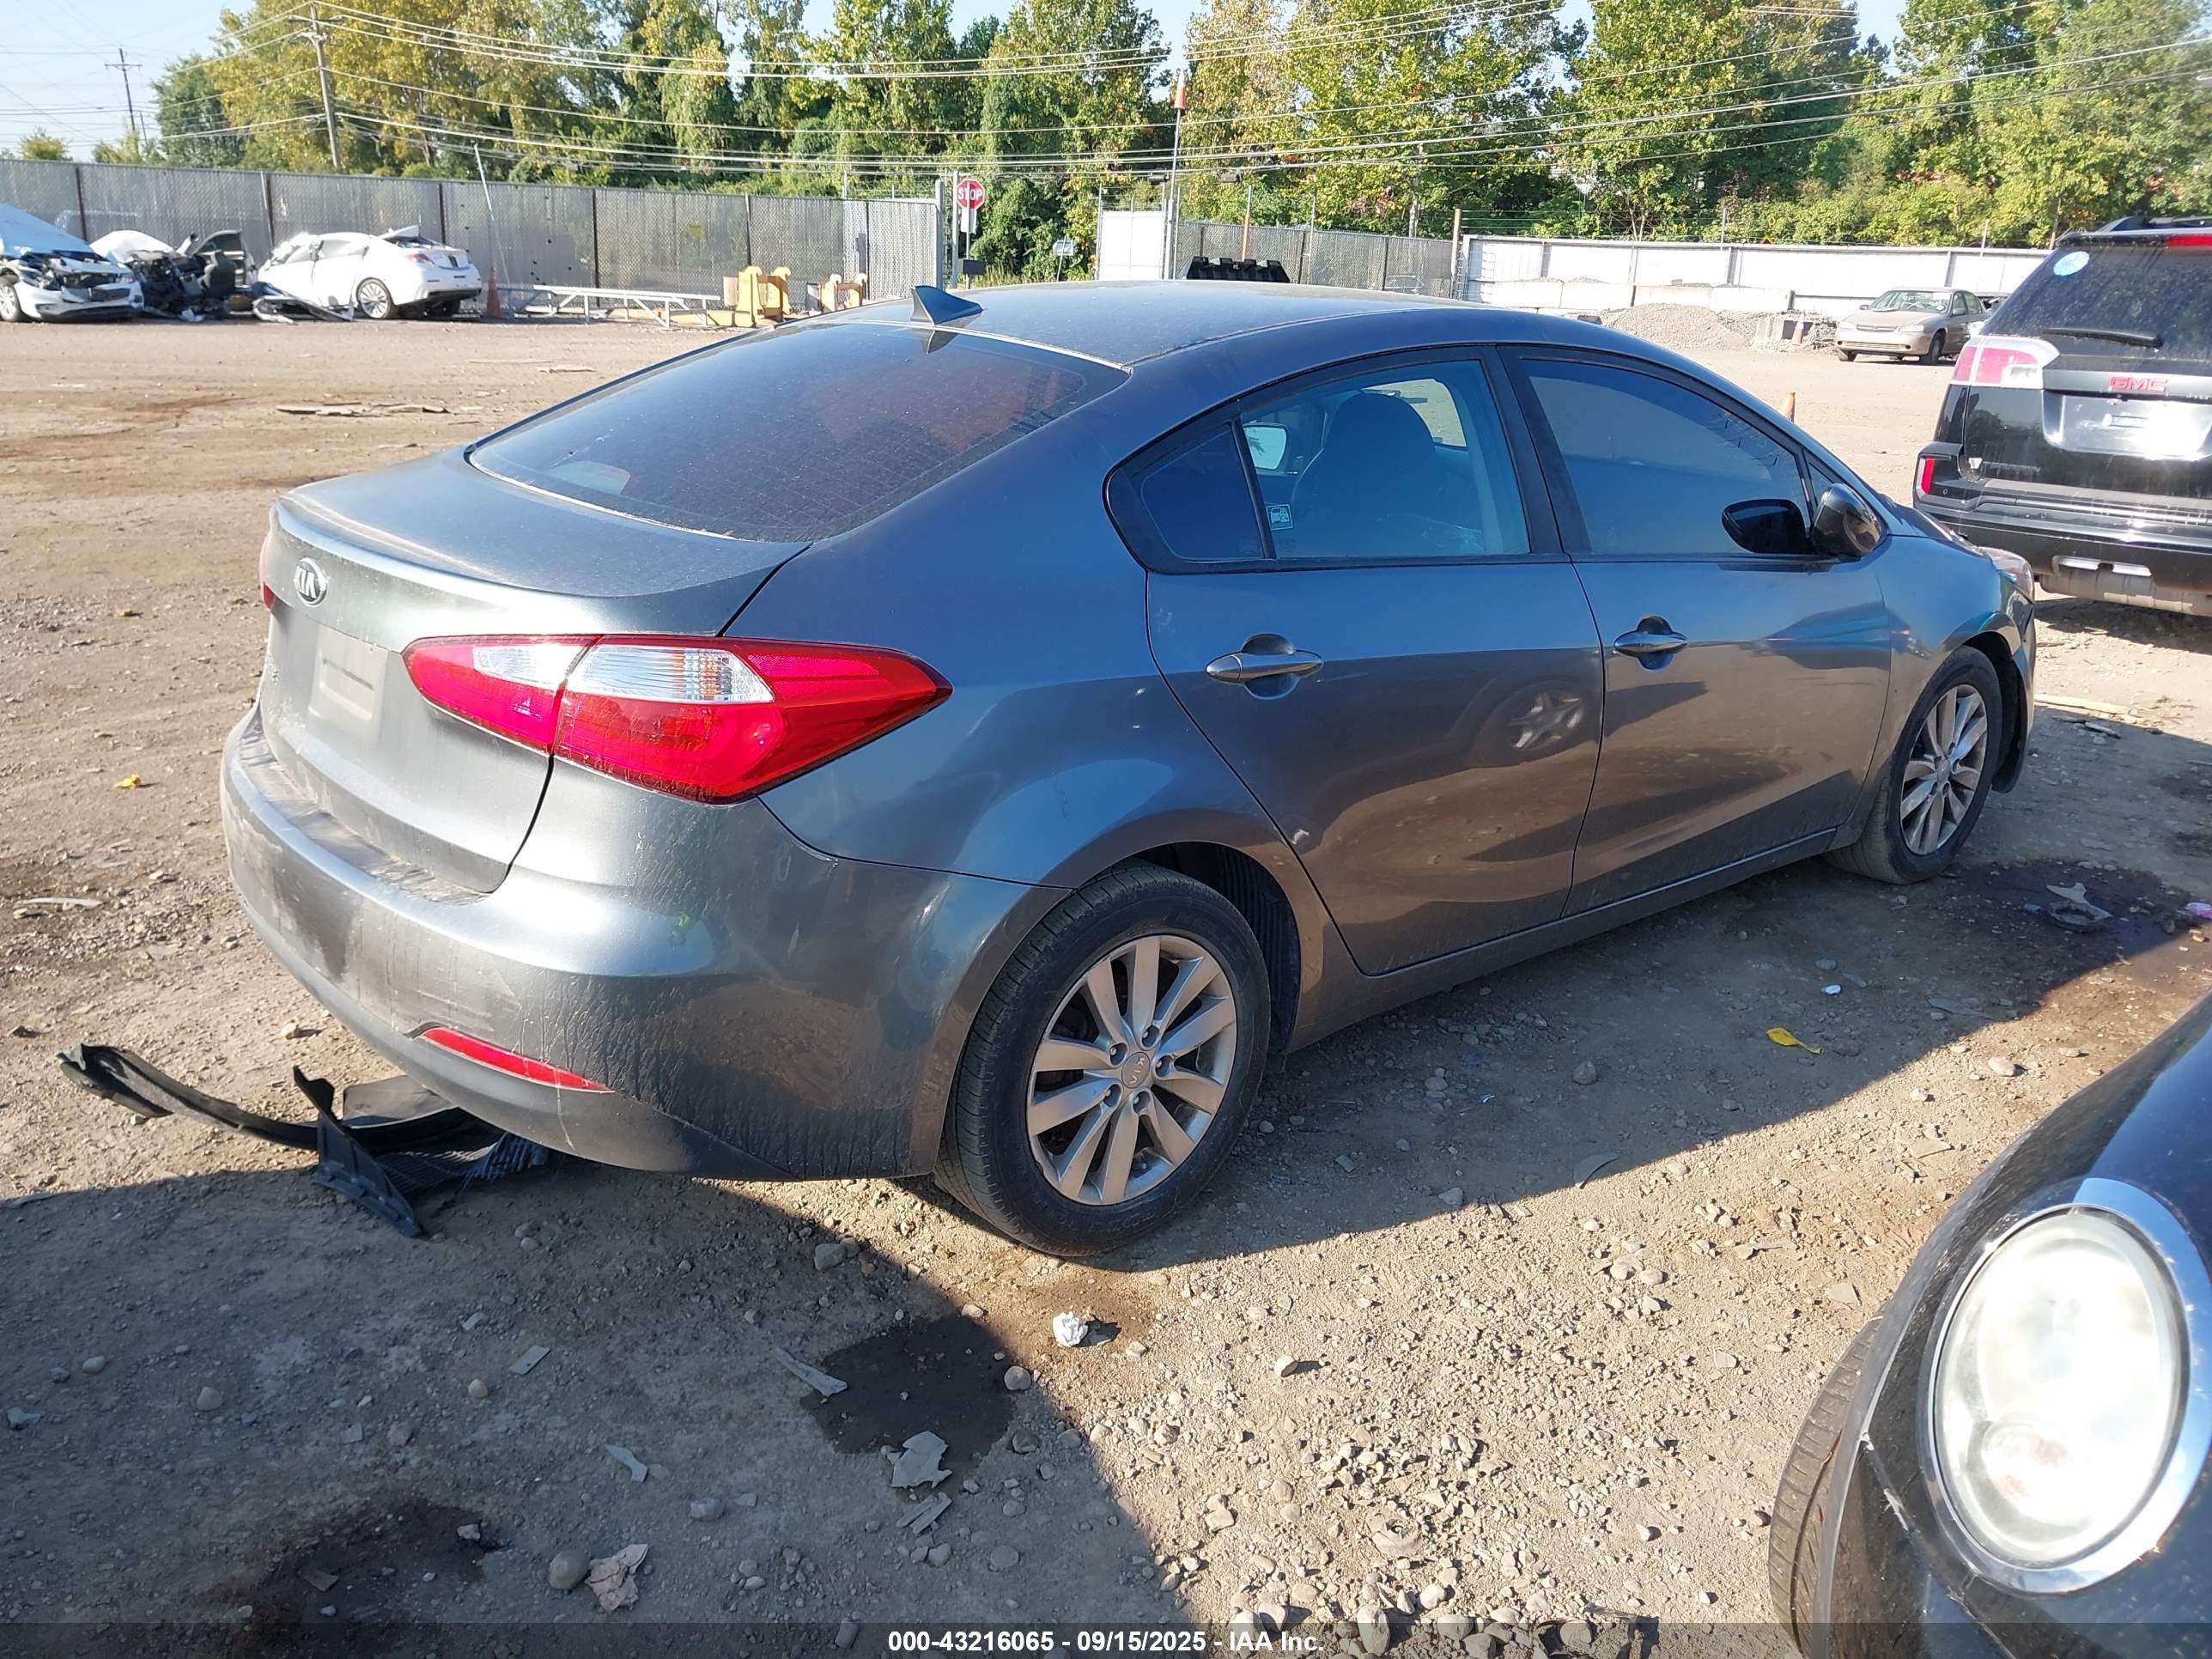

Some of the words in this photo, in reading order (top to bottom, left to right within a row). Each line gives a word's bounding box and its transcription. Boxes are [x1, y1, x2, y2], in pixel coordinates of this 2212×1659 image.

[957, 187, 983, 201] STOP
[2110, 376, 2168, 392] GMC
[1129, 1057, 1146, 1084] KIA
